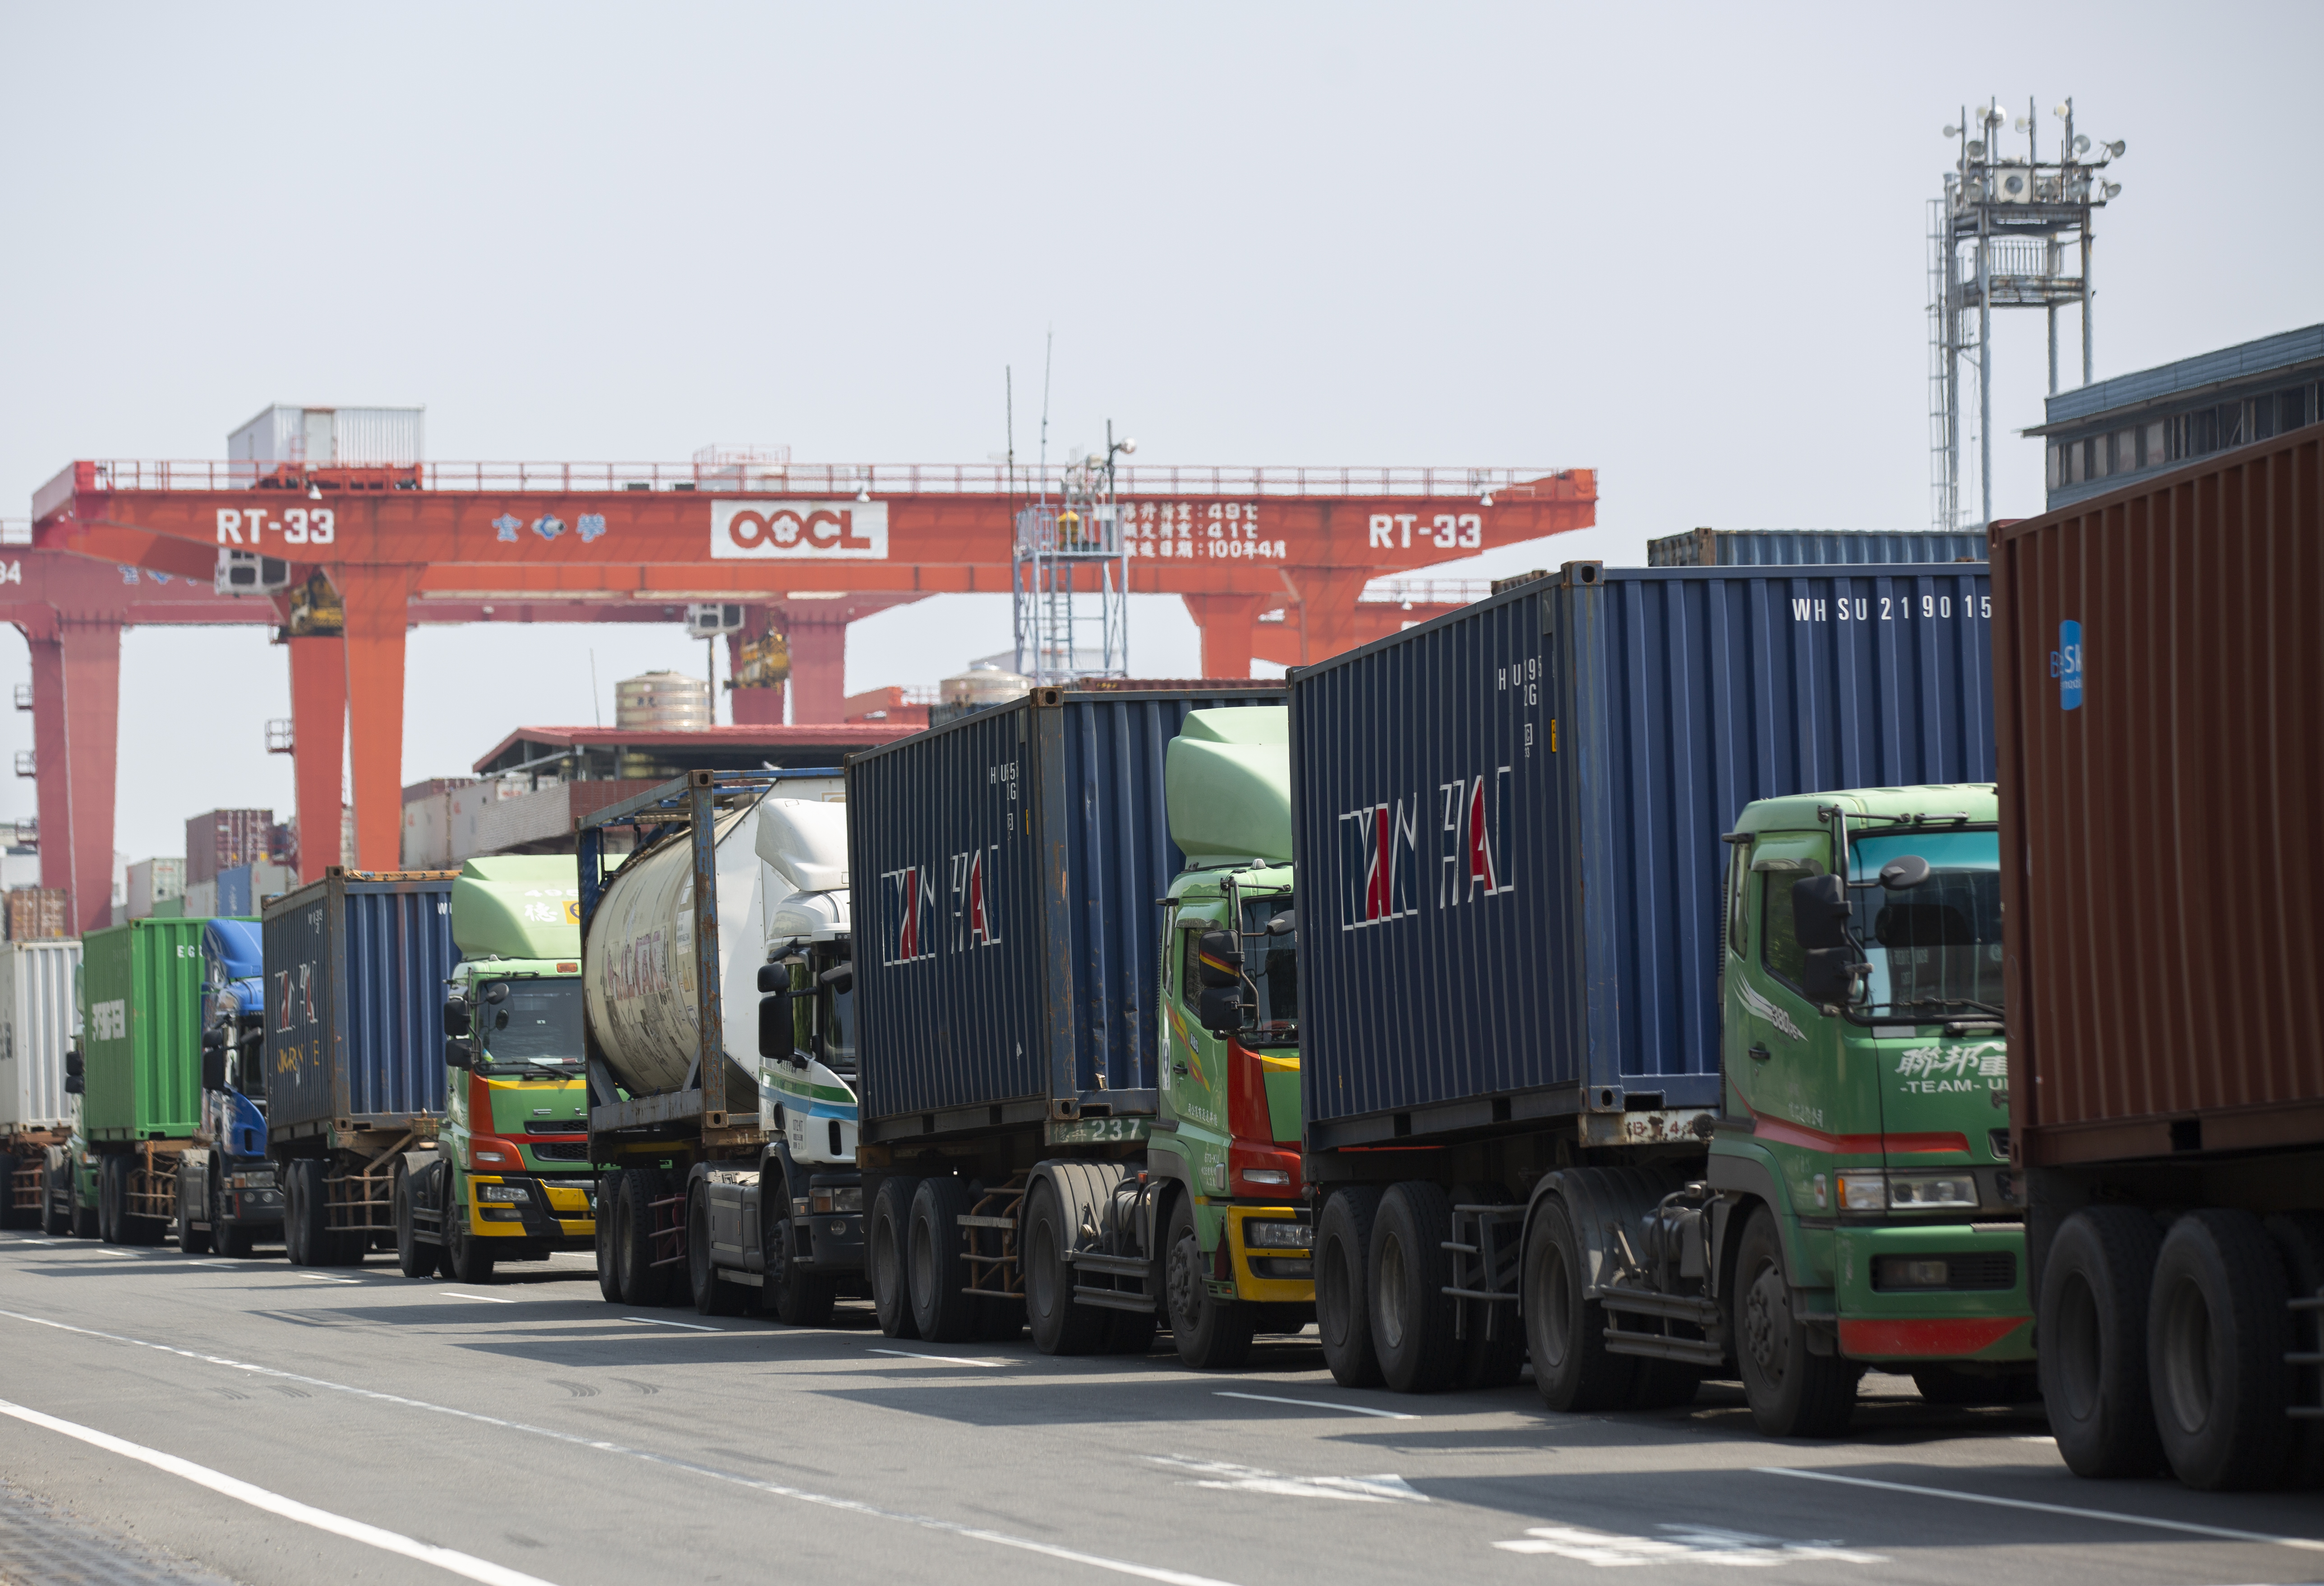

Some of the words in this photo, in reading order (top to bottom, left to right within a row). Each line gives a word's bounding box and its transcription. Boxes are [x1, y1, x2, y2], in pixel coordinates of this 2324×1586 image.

[217, 508, 334, 544] RT-33
[729, 509, 871, 550] OOCL
[1369, 513, 1482, 549] RT-33
[1190, 1031, 1199, 1054] ABS
[1092, 1118, 1140, 1141] 237
[1204, 1153, 1219, 1164] 673-KU
